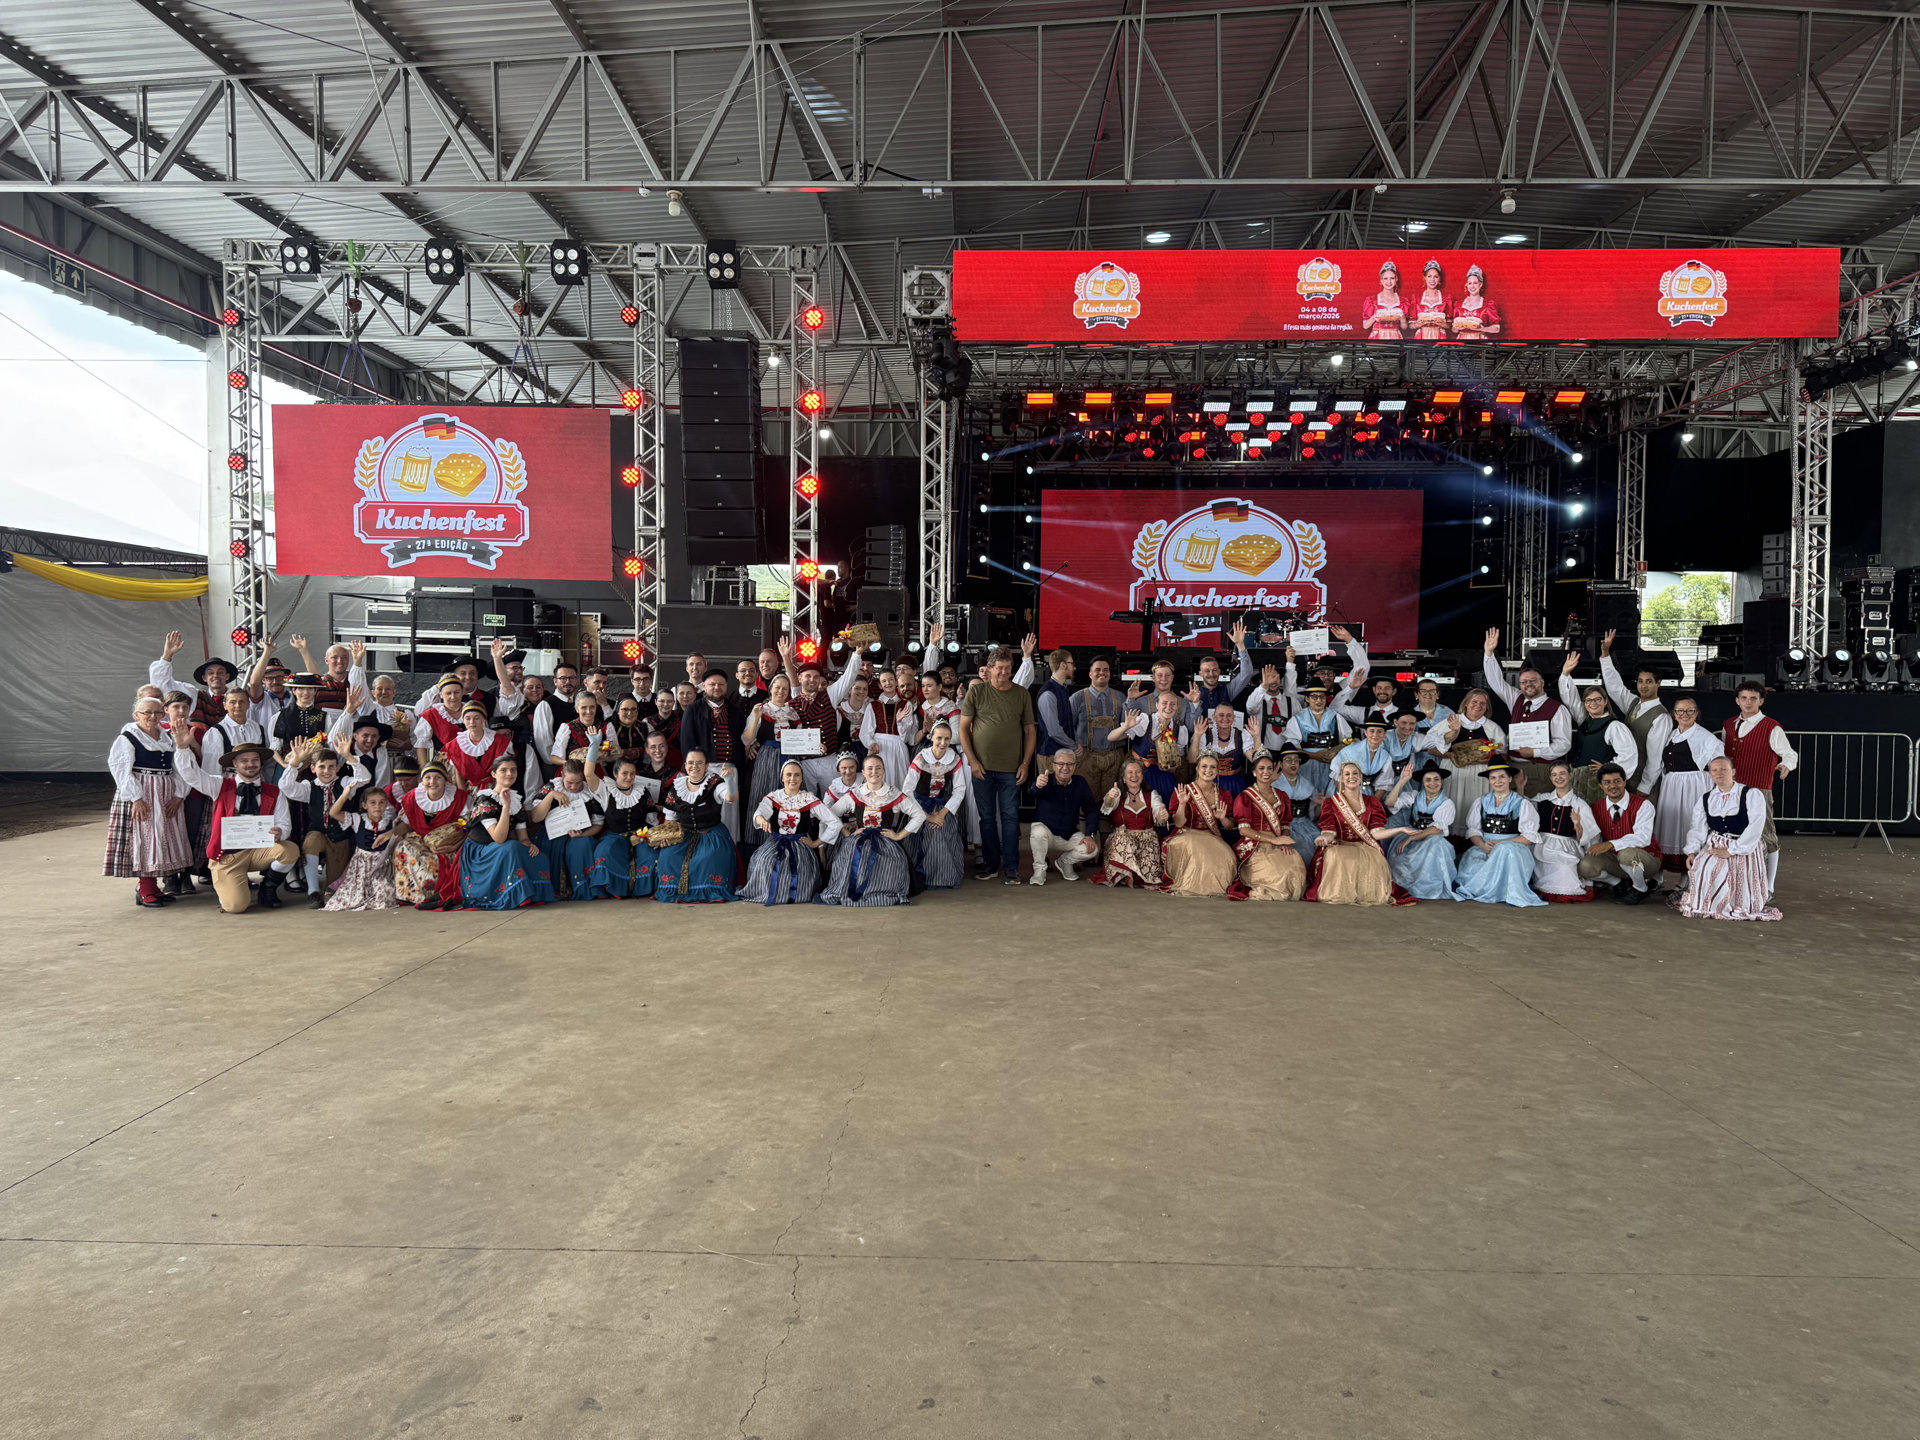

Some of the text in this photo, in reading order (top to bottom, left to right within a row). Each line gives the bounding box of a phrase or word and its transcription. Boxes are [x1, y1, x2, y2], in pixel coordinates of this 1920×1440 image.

[1081, 303, 1132, 314] Kuchenfest
[1666, 301, 1719, 312] Kuchenfest
[375, 508, 507, 535] Kuchenfest
[415, 539, 468, 551] 27ª EDIÇÃO
[1154, 587, 1302, 610] Kuchenfest
[1198, 616, 1216, 626] 27ª
